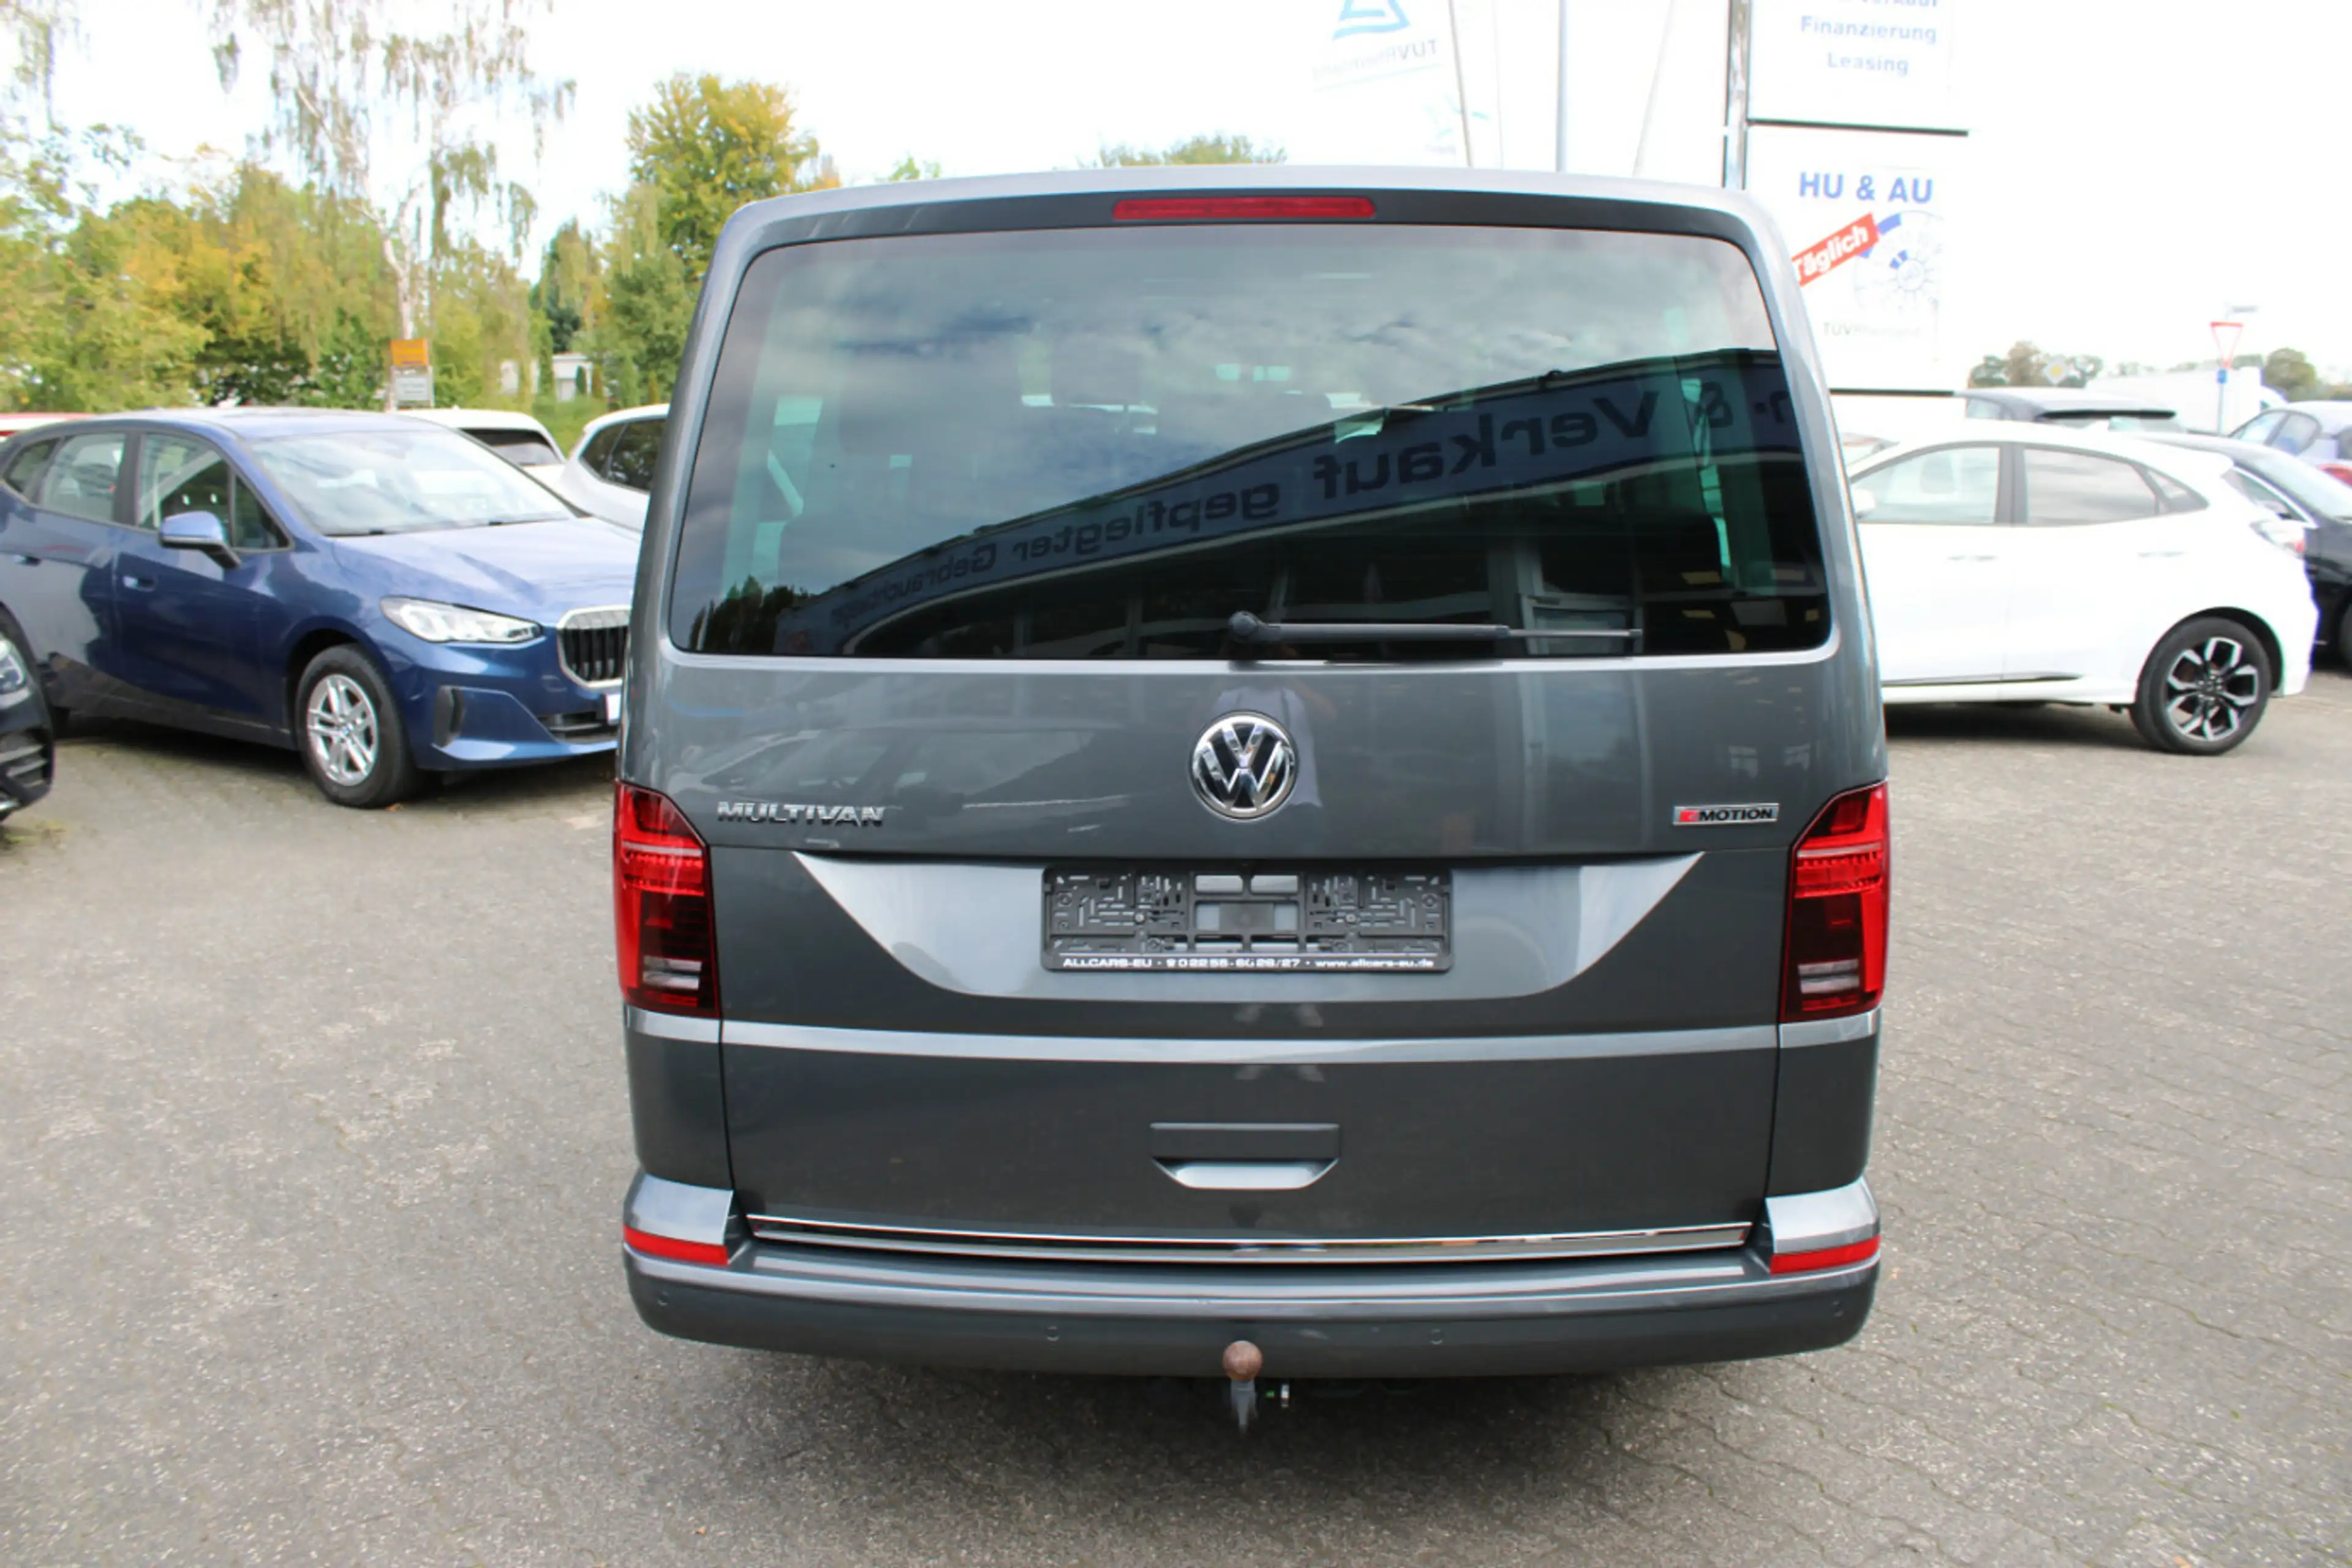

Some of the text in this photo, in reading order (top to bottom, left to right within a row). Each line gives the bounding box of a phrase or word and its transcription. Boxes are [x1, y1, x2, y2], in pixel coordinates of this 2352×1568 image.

[1800, 15, 1937, 45] Finanzierung
[1827, 52, 1909, 77] Leasing
[1799, 172, 1934, 204] HU & AU
[717, 801, 886, 826] MULTIVAN
[1063, 958, 1152, 968] ALLCARS-EU
